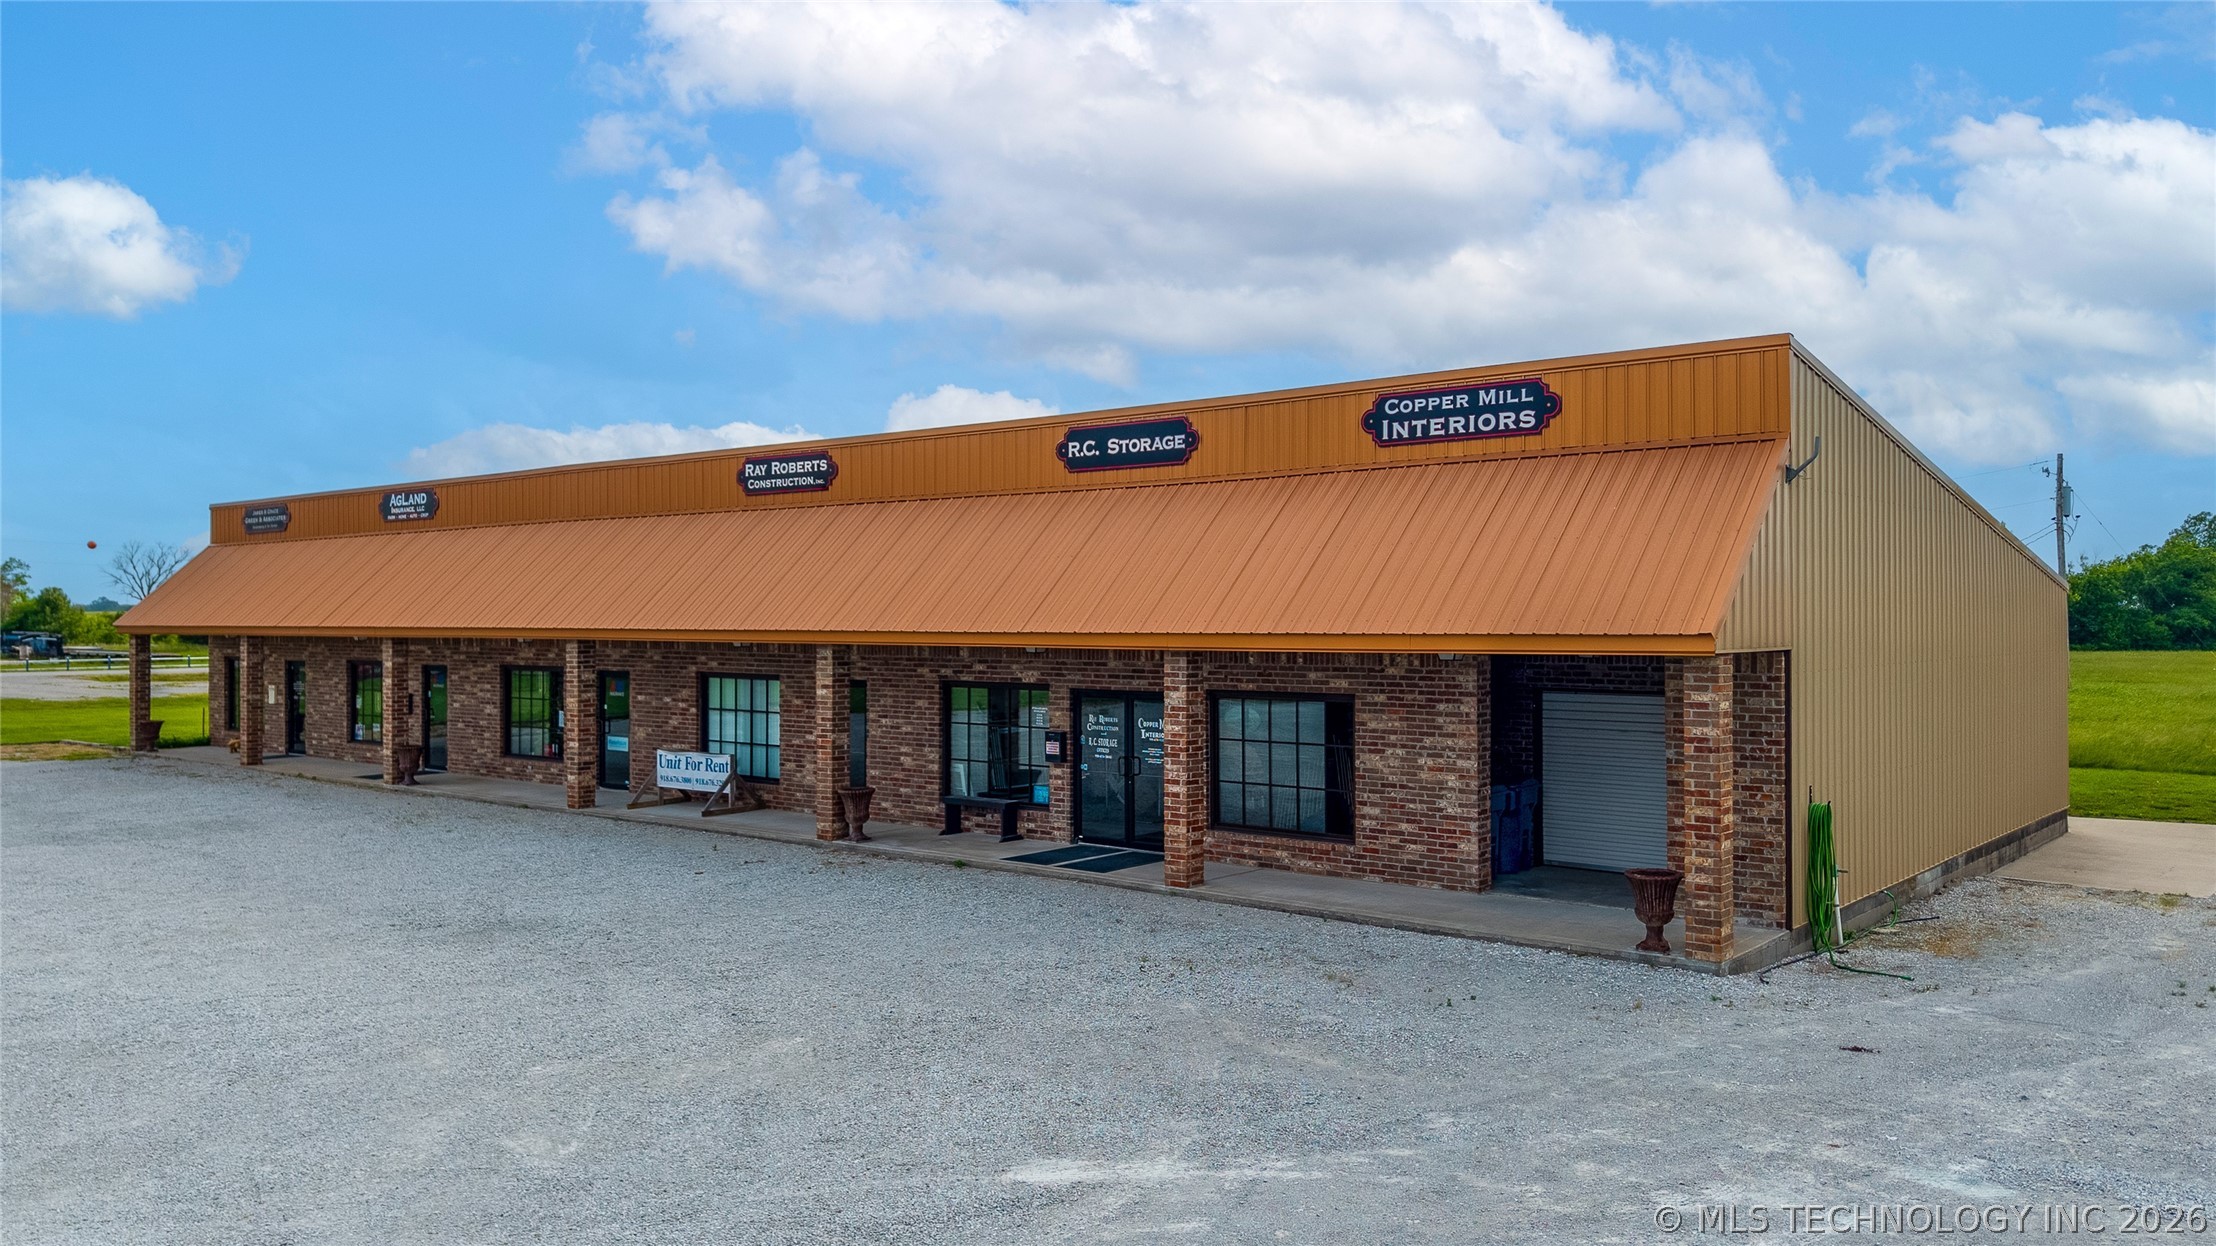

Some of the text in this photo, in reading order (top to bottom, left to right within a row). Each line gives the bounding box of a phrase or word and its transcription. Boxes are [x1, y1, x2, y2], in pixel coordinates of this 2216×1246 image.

[1384, 388, 1534, 415] COPPER MILL
[1381, 410, 1536, 440] INTERIORS
[1068, 434, 1186, 458] R.C. STORAGE
[745, 460, 827, 476] RAY ROBERTS
[1138, 718, 1158, 728] COPPER
[1141, 729, 1164, 738] INTERIO
[659, 754, 729, 773] Unit For Rent
